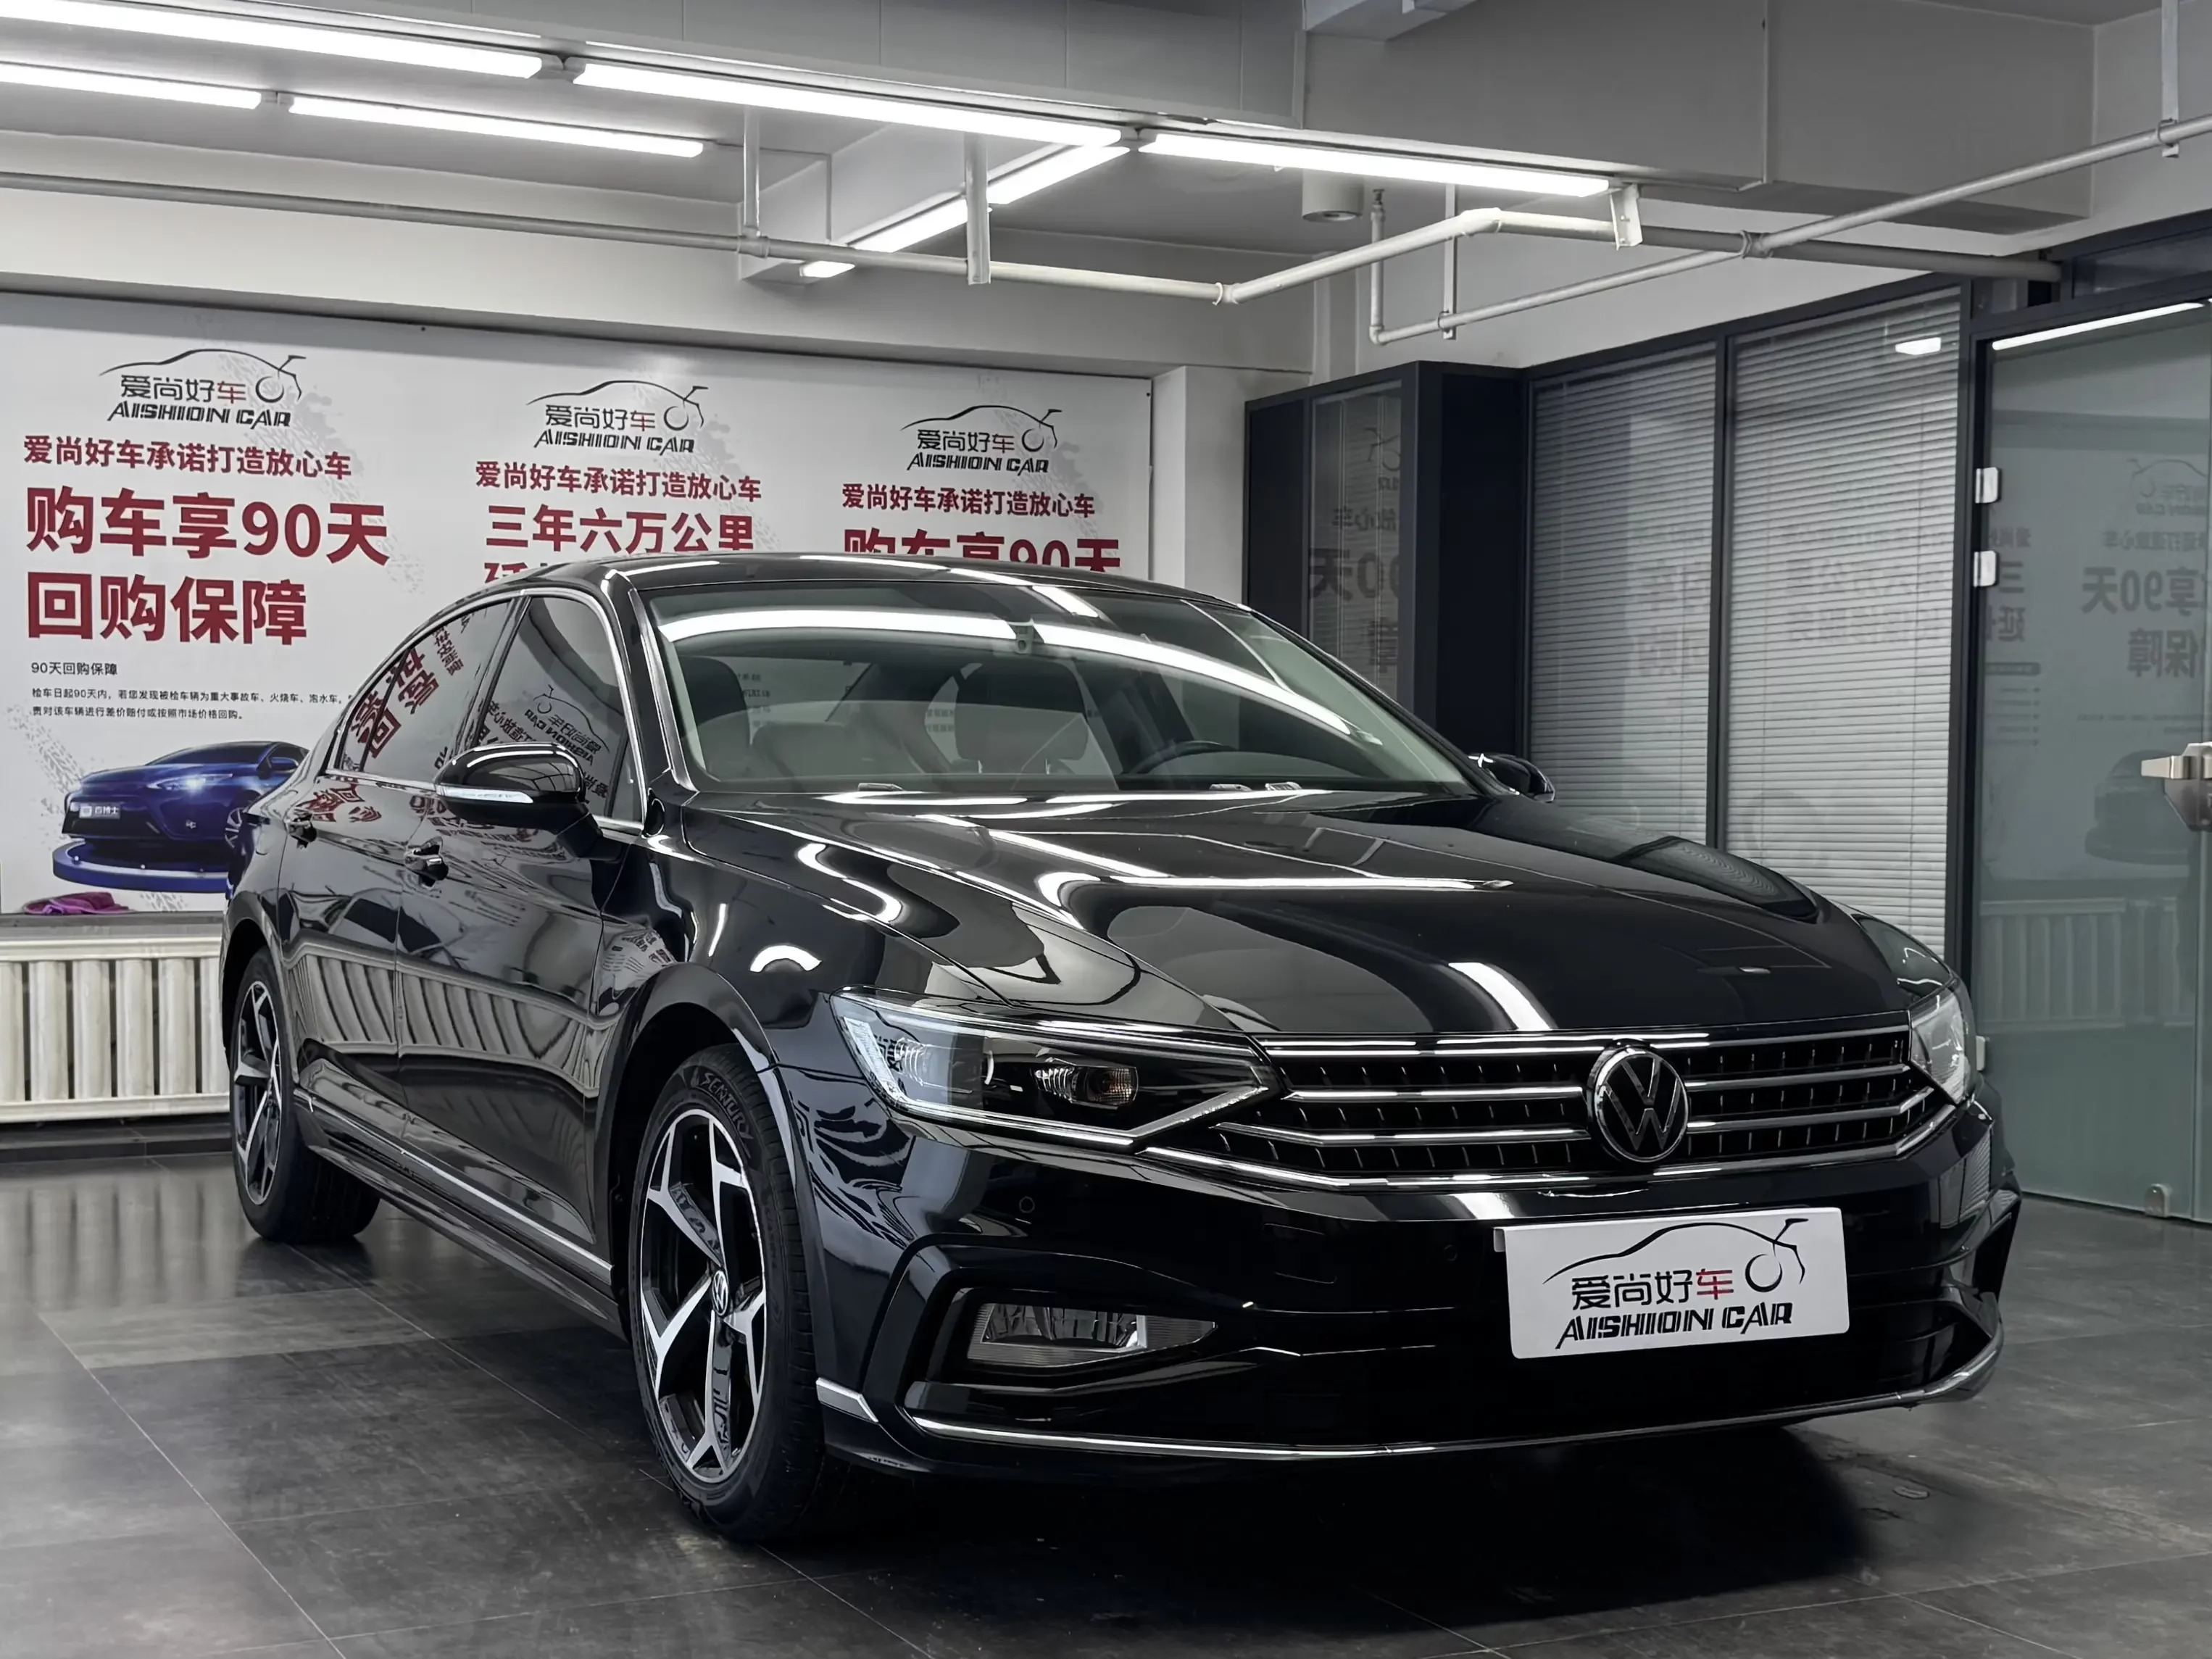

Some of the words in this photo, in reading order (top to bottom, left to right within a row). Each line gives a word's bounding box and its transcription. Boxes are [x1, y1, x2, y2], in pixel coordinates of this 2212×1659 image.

[120, 374, 247, 404] 爱尚好车
[107, 401, 230, 423] AISHION
[236, 409, 292, 429] CAR
[545, 404, 657, 432] 爱尚好车
[23, 435, 352, 480] 爱尚好车承诺打造放心车
[533, 428, 642, 451] AISHION
[646, 436, 695, 456] CAR
[917, 428, 1015, 454] 爱尚好车
[475, 460, 762, 502] 爱尚好车承诺打造放心车
[906, 452, 1002, 472] AISHION
[1005, 457, 1049, 476] CAR
[841, 483, 1095, 518] 爱尚好车承诺打造放心车
[26, 485, 390, 567] 购车享90天
[486, 504, 754, 554] 三年六万公里
[28, 571, 307, 646] 回购保障
[31, 662, 118, 675] 90天回购保障
[1571, 1268, 1735, 1312] 爱尚好车
[1555, 1307, 1714, 1350] AISHION
[1721, 1301, 1795, 1335] CAR
